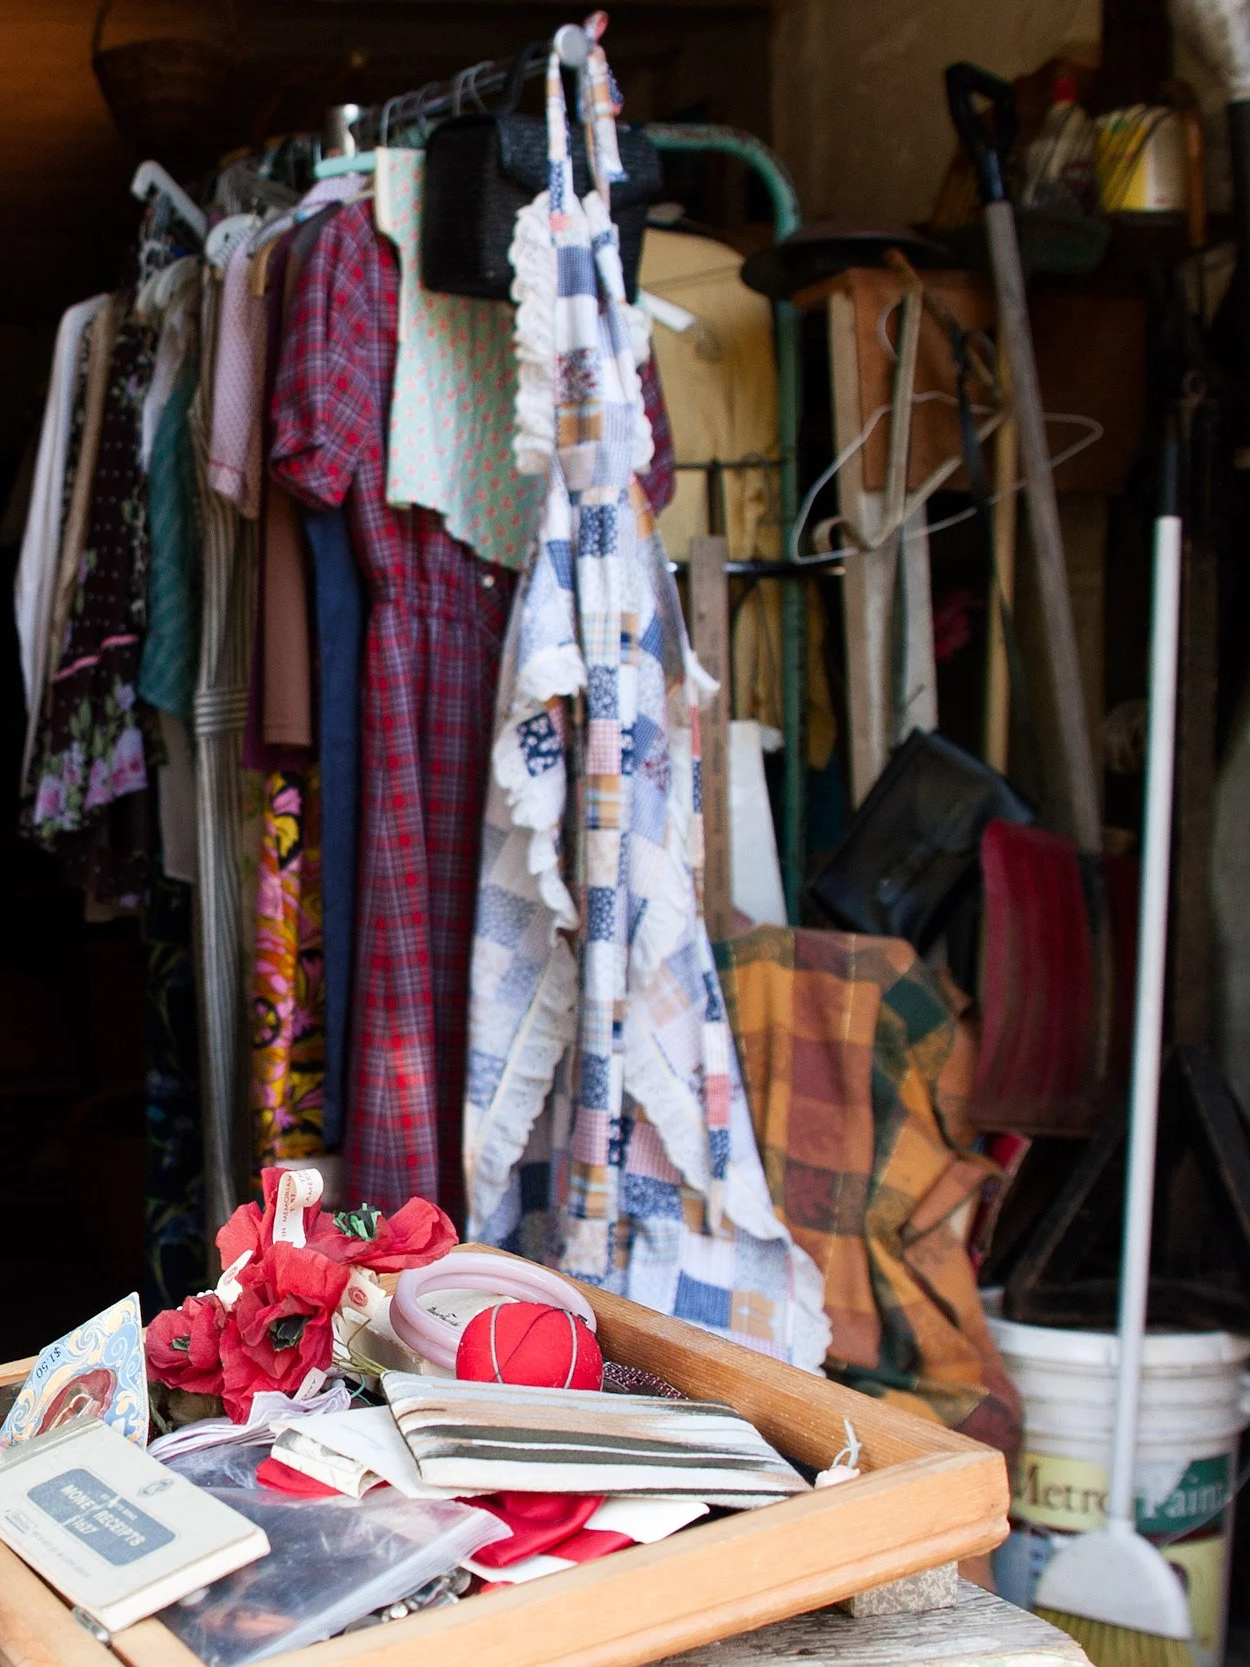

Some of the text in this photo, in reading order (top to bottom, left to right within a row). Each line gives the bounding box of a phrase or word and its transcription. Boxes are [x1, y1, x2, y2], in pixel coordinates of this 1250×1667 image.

[36, 1346, 61, 1379] $1.50
[60, 1483, 103, 1512] MONEY
[93, 1510, 146, 1547] RECEIPTS
